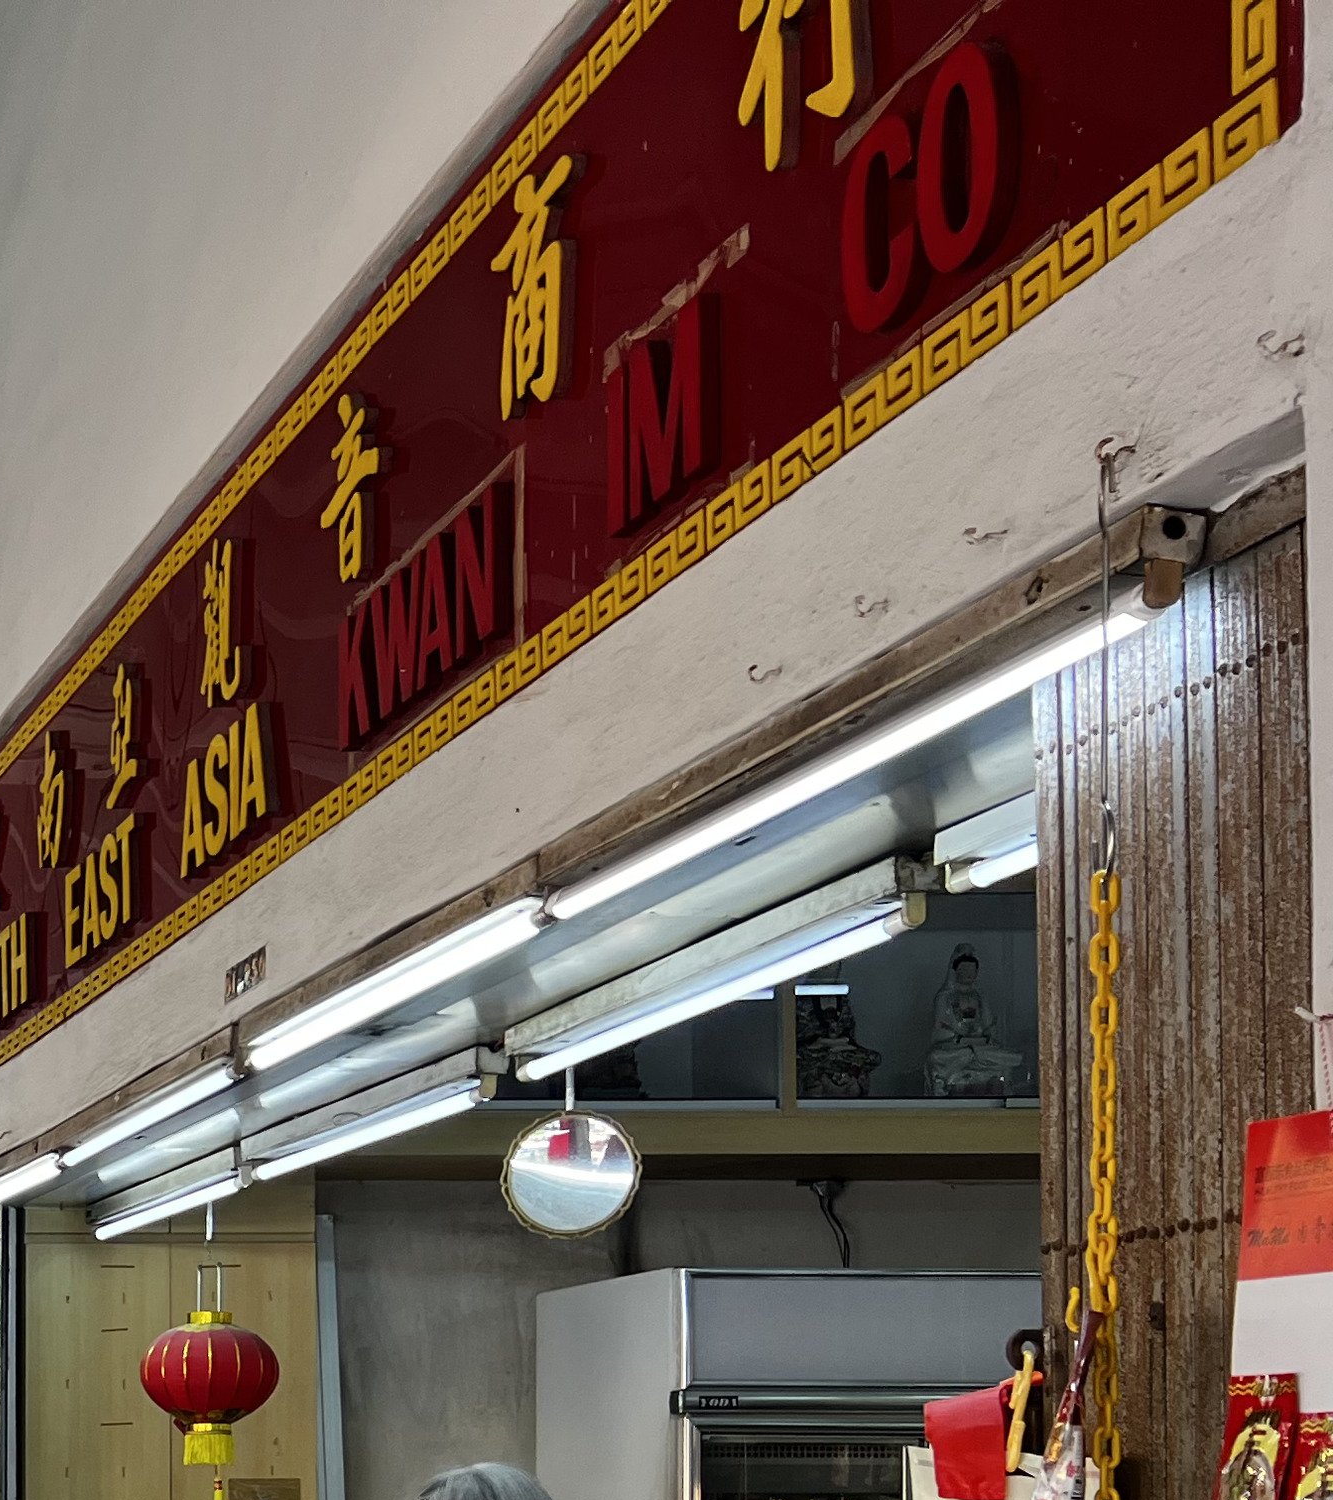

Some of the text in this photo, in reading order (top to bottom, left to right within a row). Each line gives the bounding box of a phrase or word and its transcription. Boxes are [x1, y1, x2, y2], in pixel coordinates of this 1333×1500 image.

[65, 813, 135, 969] EAST
[181, 703, 268, 879] ASIA
[338, 483, 496, 752] KWAN
[606, 293, 702, 539] IM
[841, 42, 1000, 334] CO
